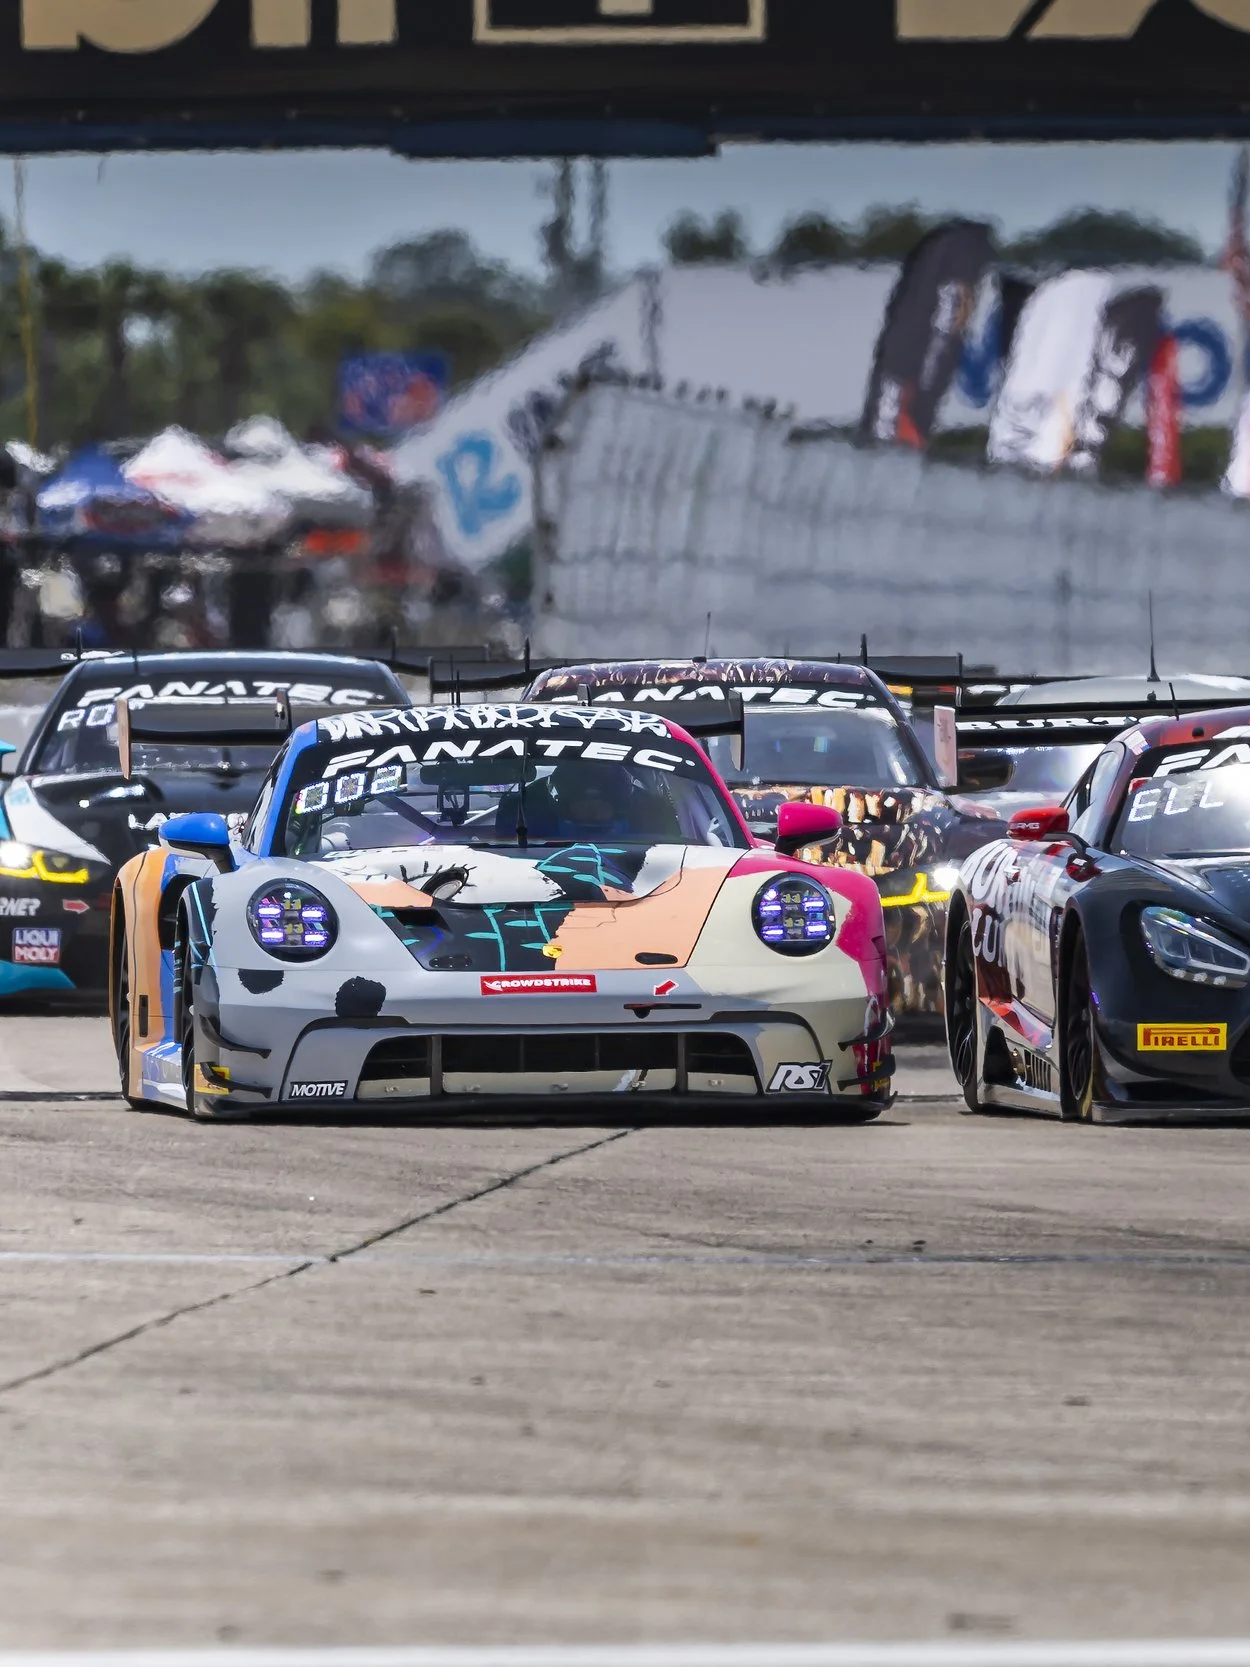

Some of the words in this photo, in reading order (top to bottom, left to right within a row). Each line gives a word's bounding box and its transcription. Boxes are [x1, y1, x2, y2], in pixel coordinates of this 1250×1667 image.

[77, 681, 376, 707] FANATEC
[323, 739, 683, 778] FANATEC
[15, 930, 59, 946] LIQUI
[14, 946, 59, 961] MOLY
[488, 978, 592, 990] CROWDSTRIKE
[1143, 1027, 1221, 1046] PIRELLI
[291, 1083, 345, 1097] MOTIVE
